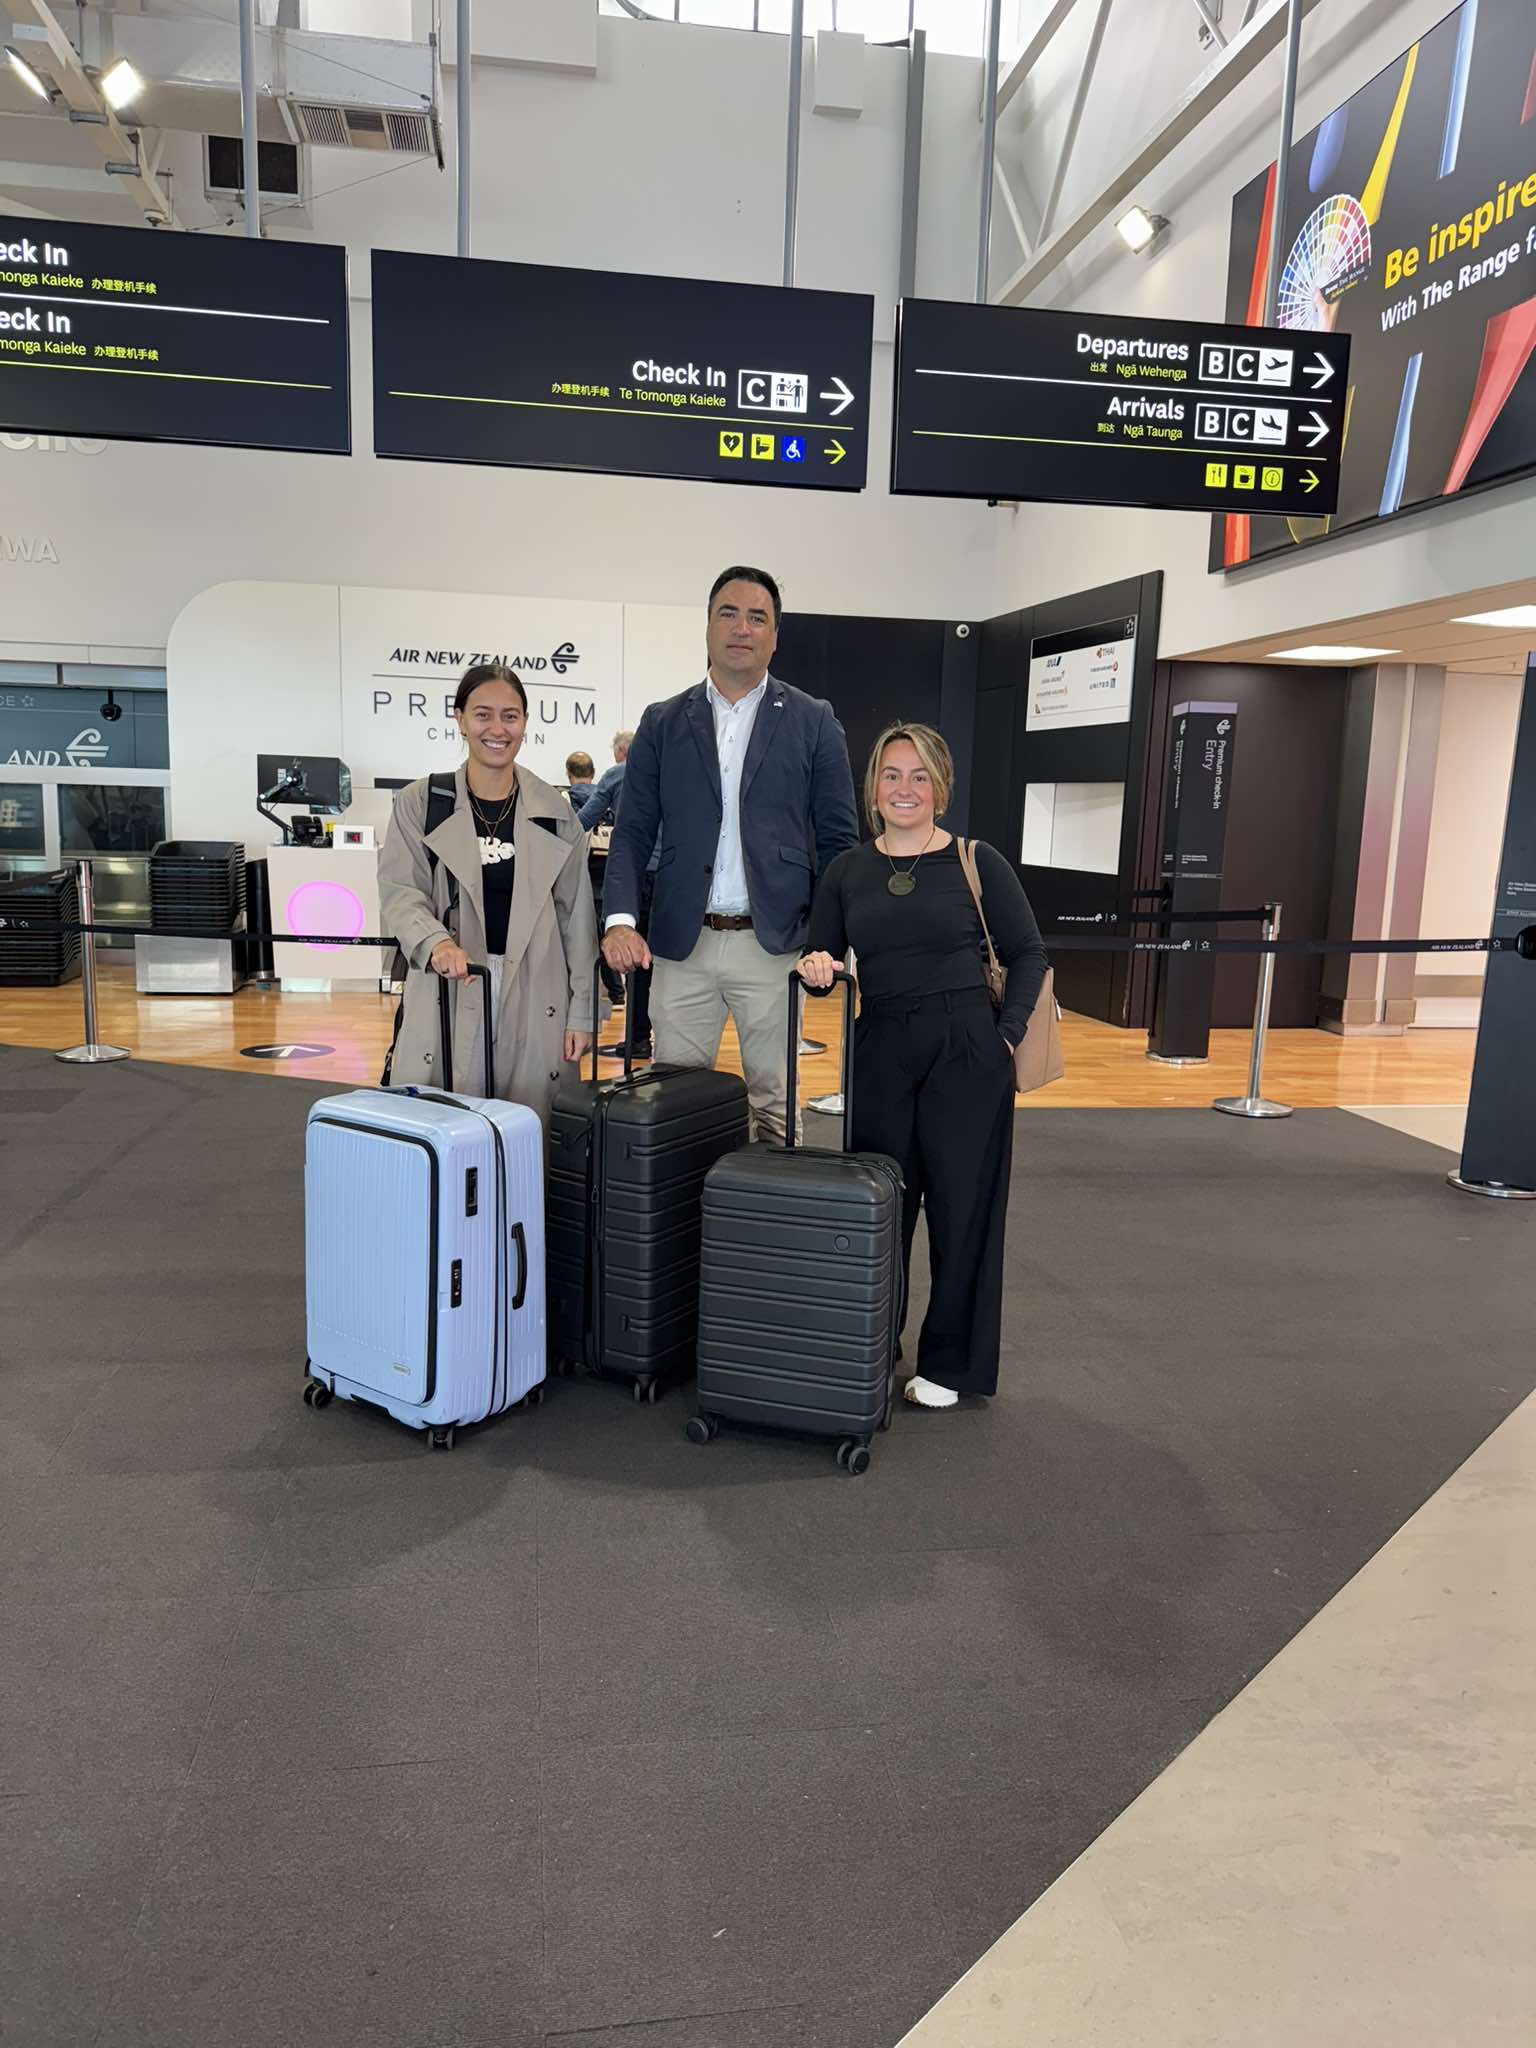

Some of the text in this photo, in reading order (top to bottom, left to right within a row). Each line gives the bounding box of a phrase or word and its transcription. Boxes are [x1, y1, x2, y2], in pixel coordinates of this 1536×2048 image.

[1384, 248, 1419, 290] Be
[1427, 172, 1536, 264] inspire
[44, 242, 69, 266] In
[41, 272, 84, 288] Kaieke
[1381, 295, 1417, 332] With
[1421, 280, 1453, 310] The
[1457, 242, 1520, 291] Range
[0, 307, 71, 334] eck In
[44, 340, 87, 356] Kaieke
[1076, 333, 1254, 377] Departures B C
[631, 359, 766, 403] Check In C
[1138, 364, 1188, 381] Wehenga
[619, 387, 633, 400] Te
[634, 388, 688, 407] Tomonga
[689, 393, 727, 408] Kaieke
[1106, 396, 1250, 437] Arrivals B C
[1146, 425, 1183, 441] Taunga
[389, 647, 547, 671] AIR NEW ZEALAND
[373, 690, 595, 726] PREUM
[1202, 740, 1217, 770] Entry
[1215, 740, 1227, 775] Premium
